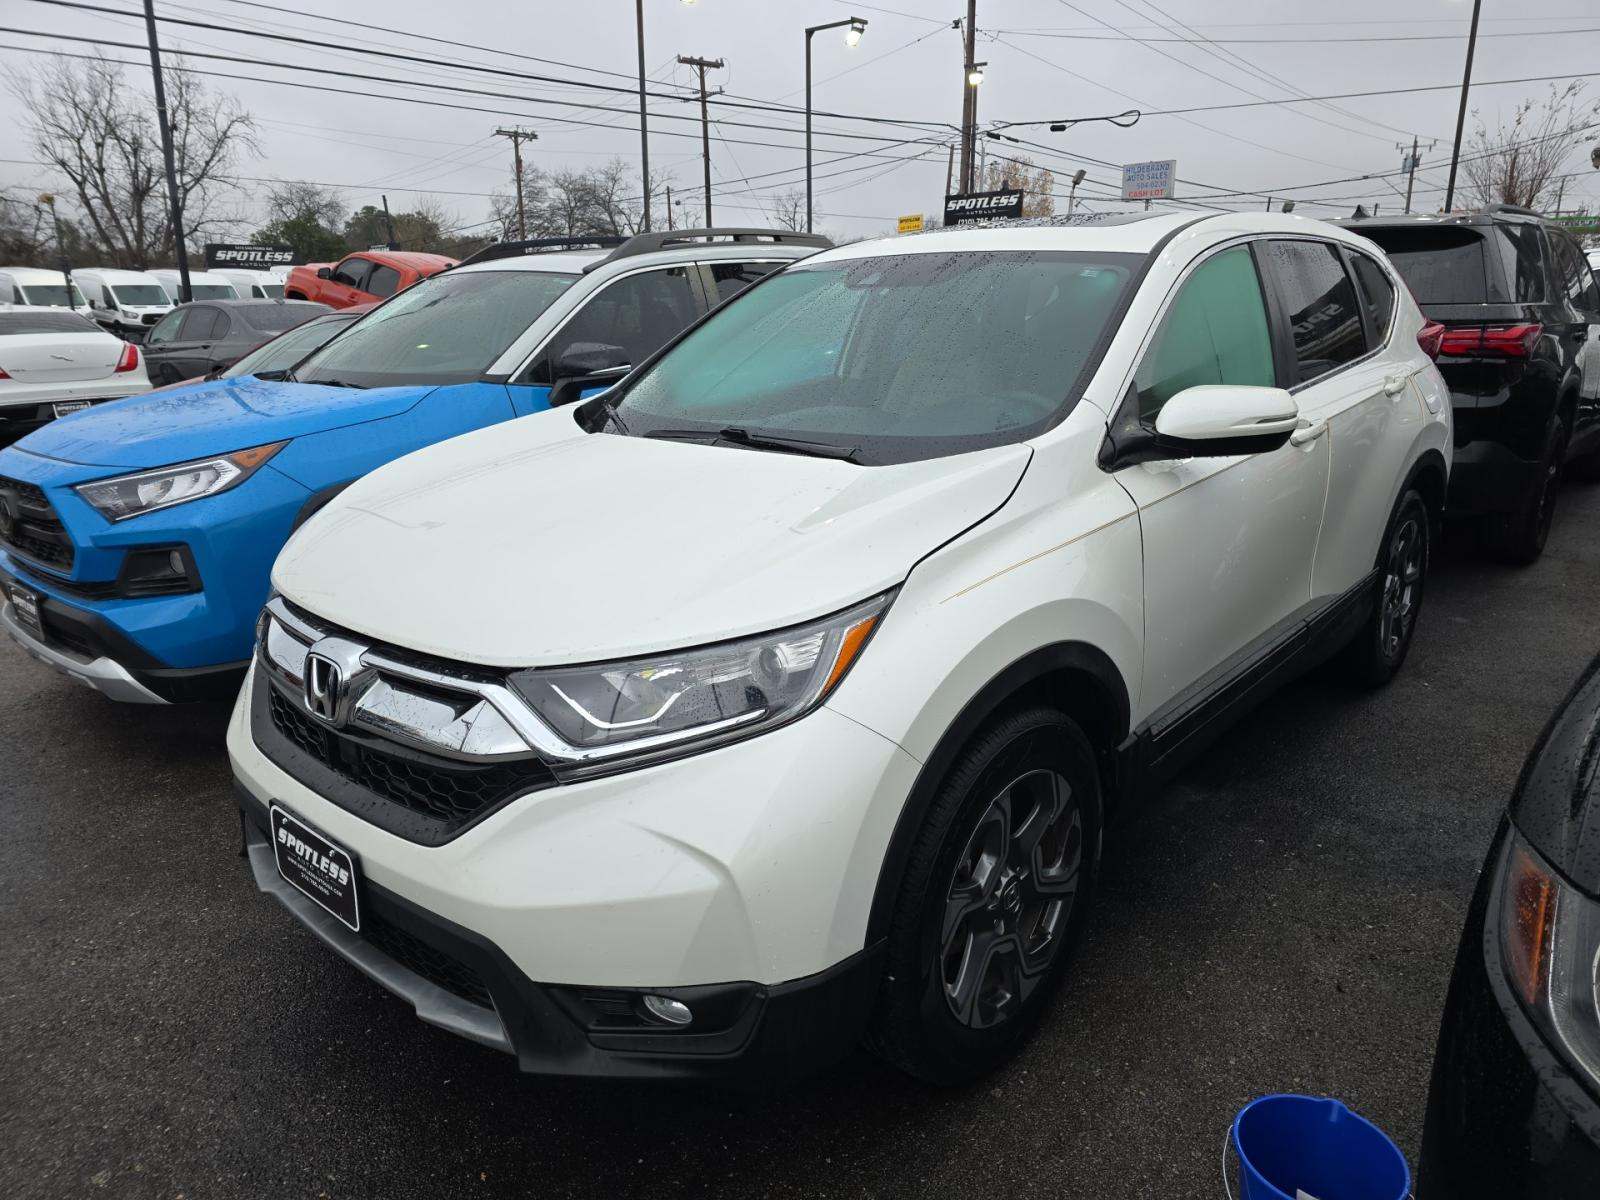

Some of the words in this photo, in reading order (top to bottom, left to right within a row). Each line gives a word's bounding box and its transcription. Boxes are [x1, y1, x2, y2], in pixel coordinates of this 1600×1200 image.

[1125, 163, 1170, 175] HILDEBRAND
[1126, 174, 1145, 182] AUTO
[1146, 171, 1169, 181] SALES
[946, 193, 1020, 211] SPOTLESS
[215, 249, 295, 263] SPOTLESS
[277, 827, 349, 886] SPOTLESS
